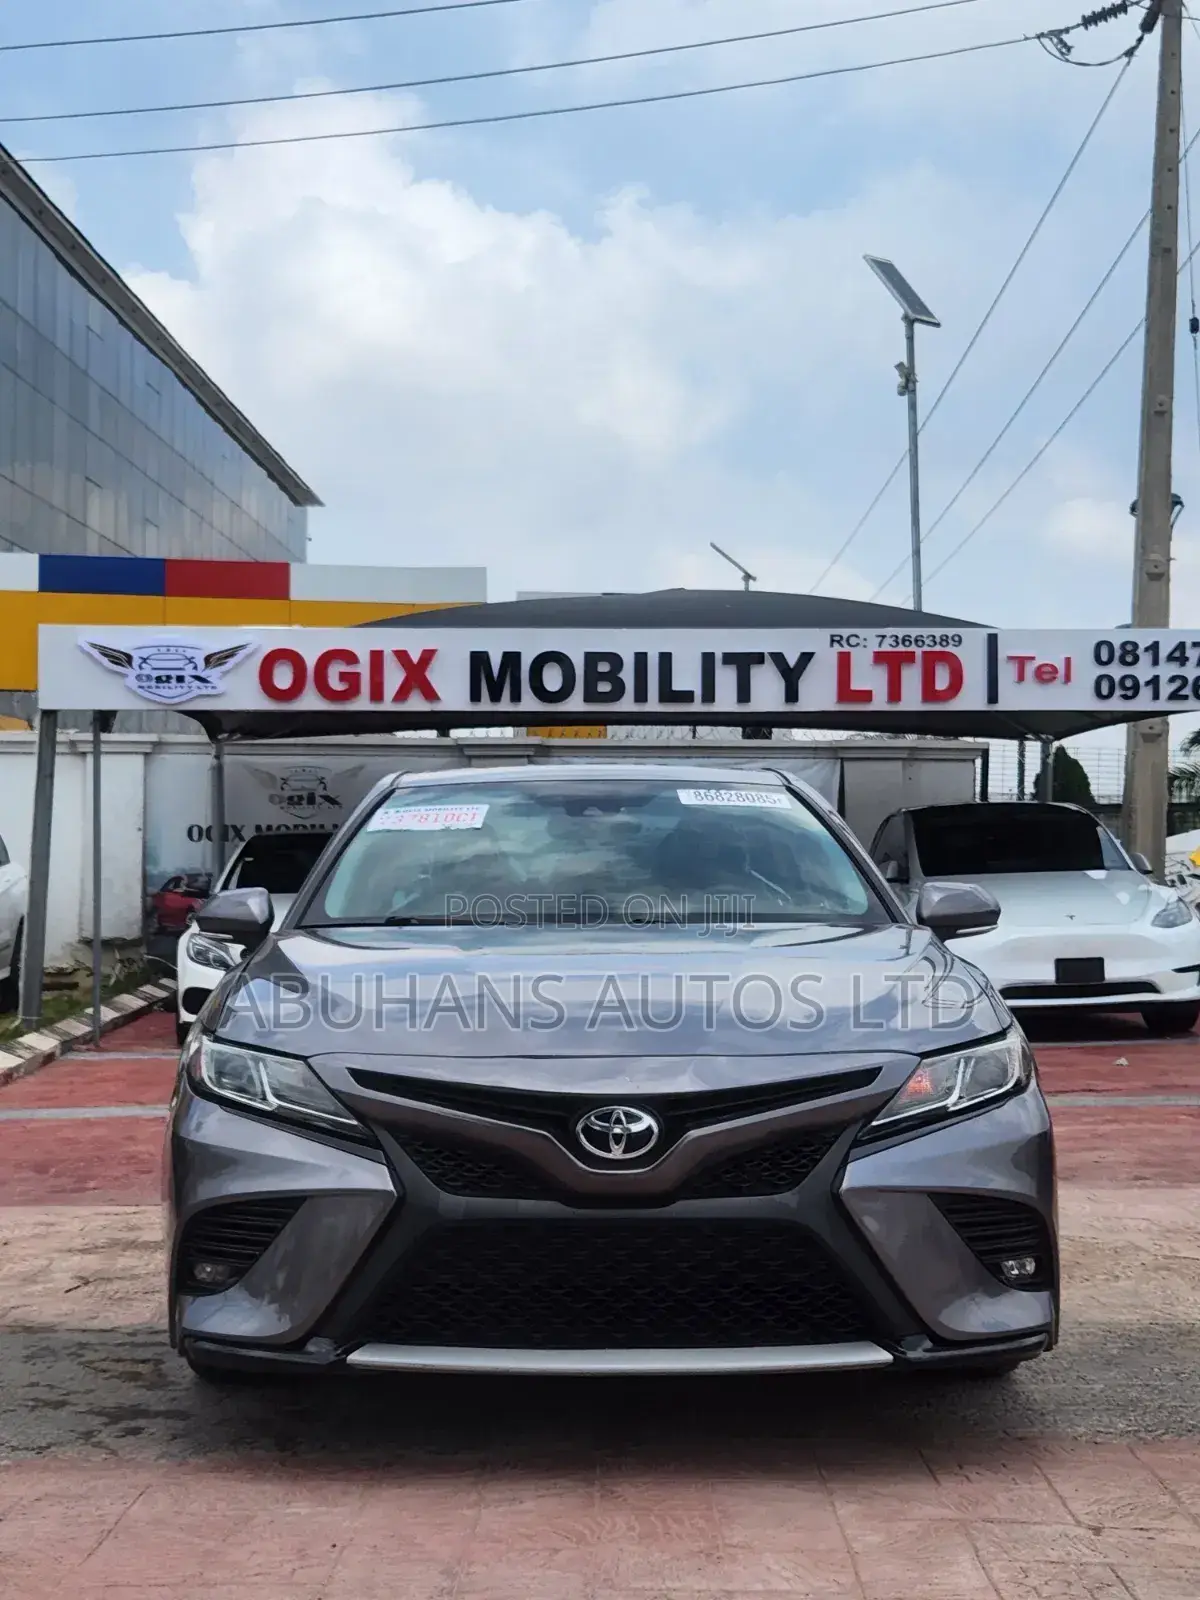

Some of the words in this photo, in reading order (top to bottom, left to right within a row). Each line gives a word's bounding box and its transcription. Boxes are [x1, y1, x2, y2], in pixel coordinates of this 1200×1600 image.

[829, 633, 868, 648] RC:
[876, 633, 964, 648] 7366389
[258, 647, 442, 703] OGIX
[469, 650, 816, 704] MOBILITY
[835, 650, 964, 704] LTD
[1007, 655, 1073, 684] Tel
